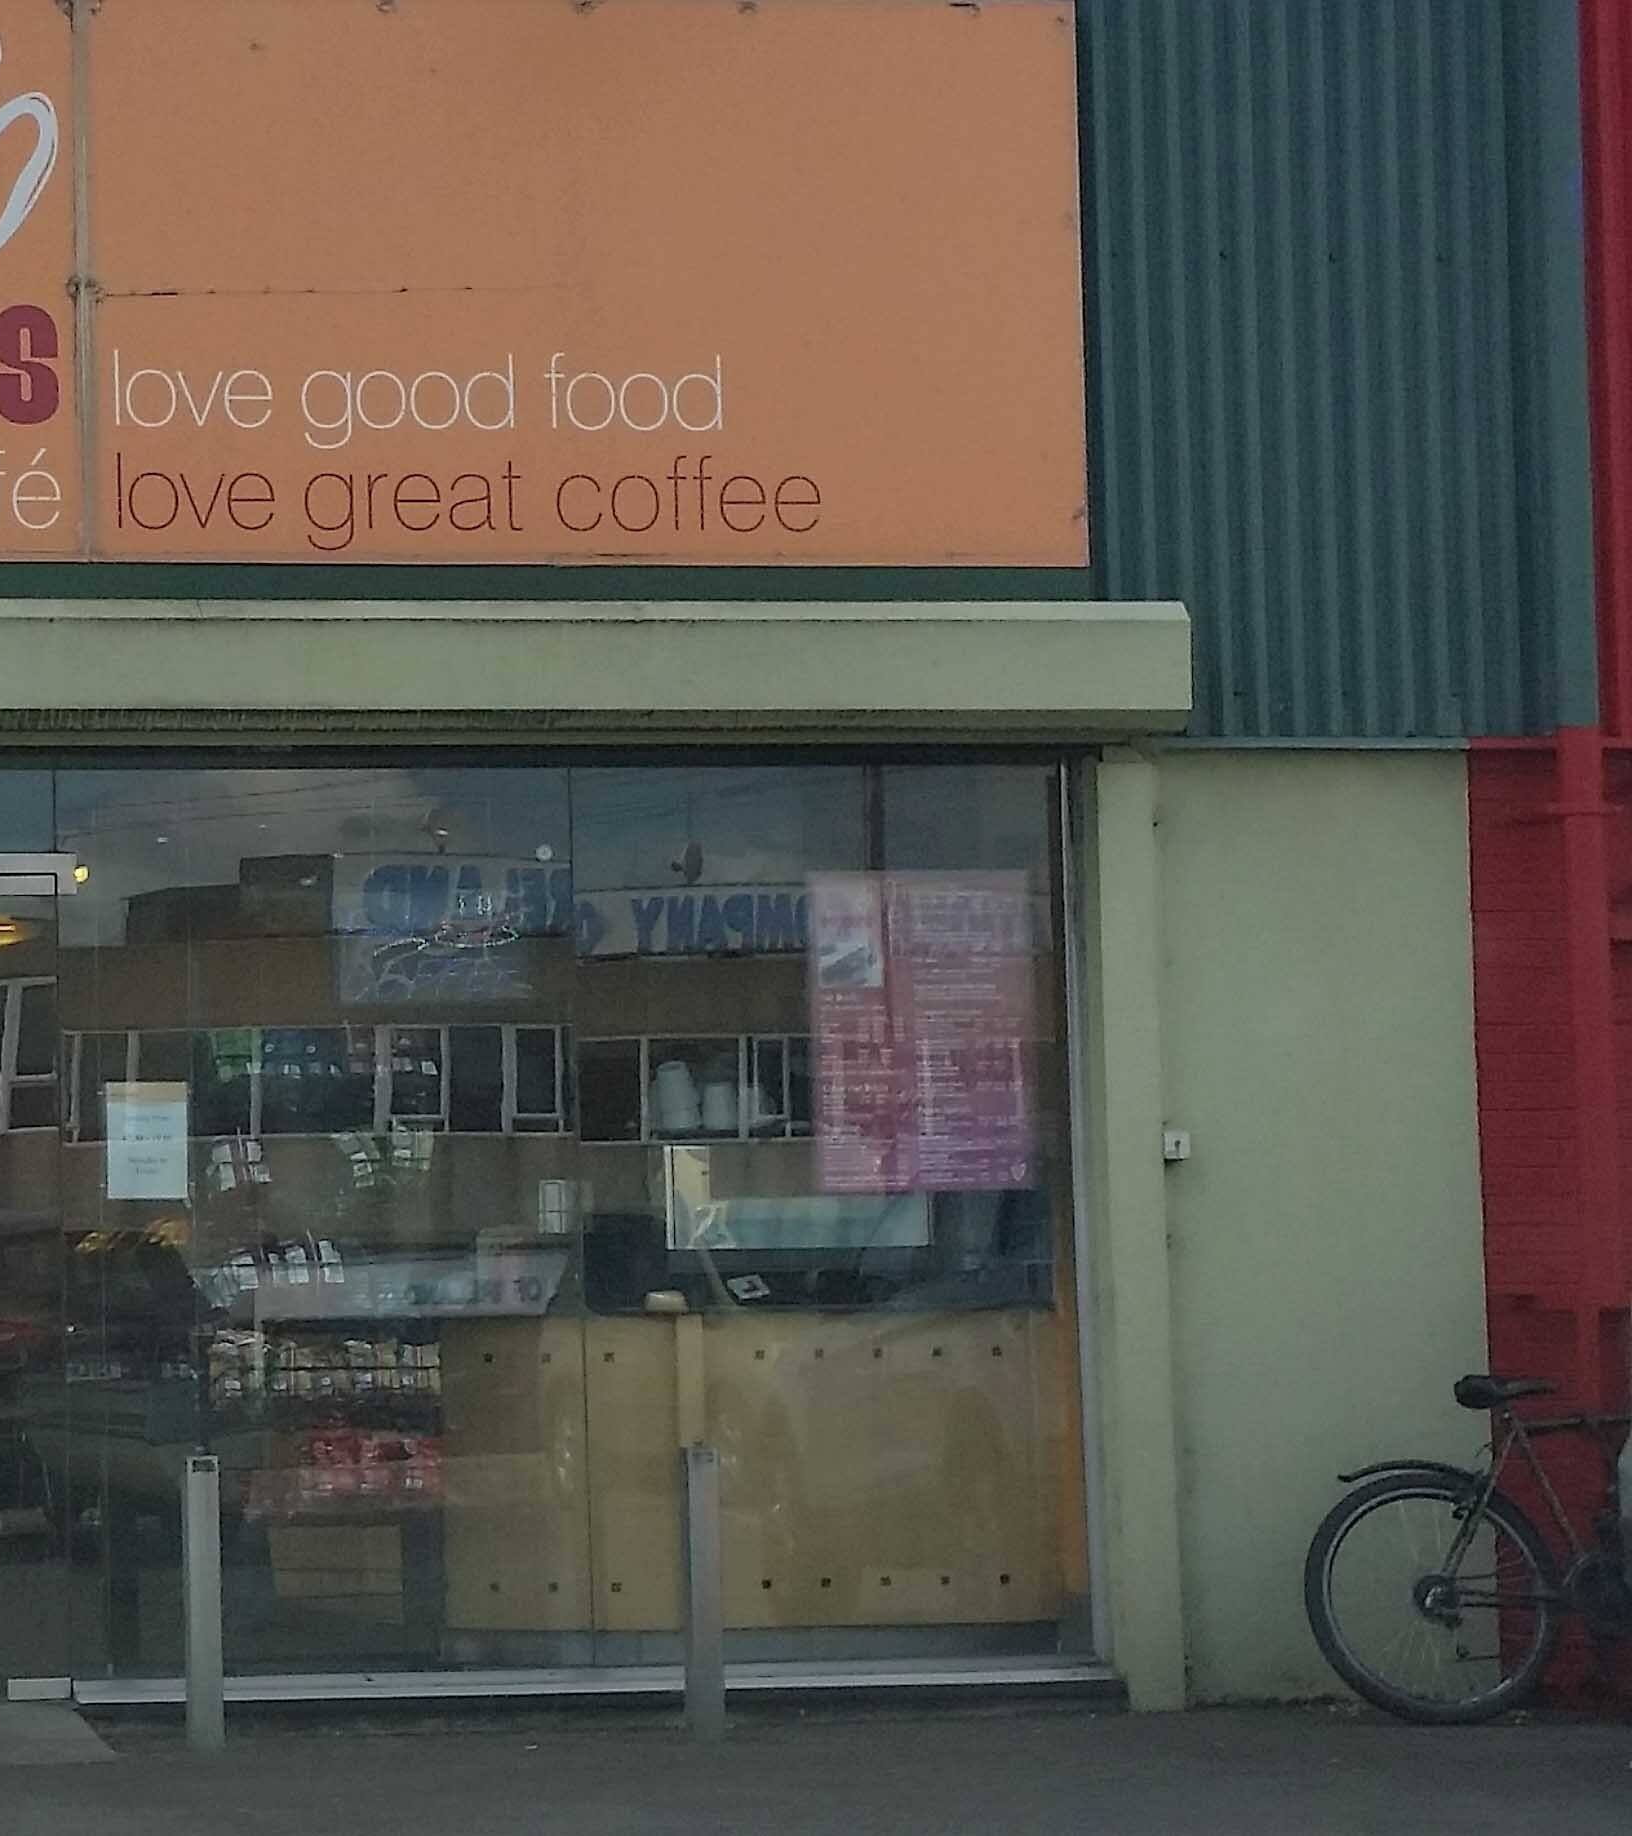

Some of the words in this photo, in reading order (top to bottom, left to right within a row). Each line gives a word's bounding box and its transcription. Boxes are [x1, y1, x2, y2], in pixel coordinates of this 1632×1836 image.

[113, 348, 273, 428] love
[300, 353, 516, 450] good
[544, 351, 724, 432] food
[115, 451, 276, 530] love
[303, 460, 523, 551] great
[556, 455, 823, 533] coffee
